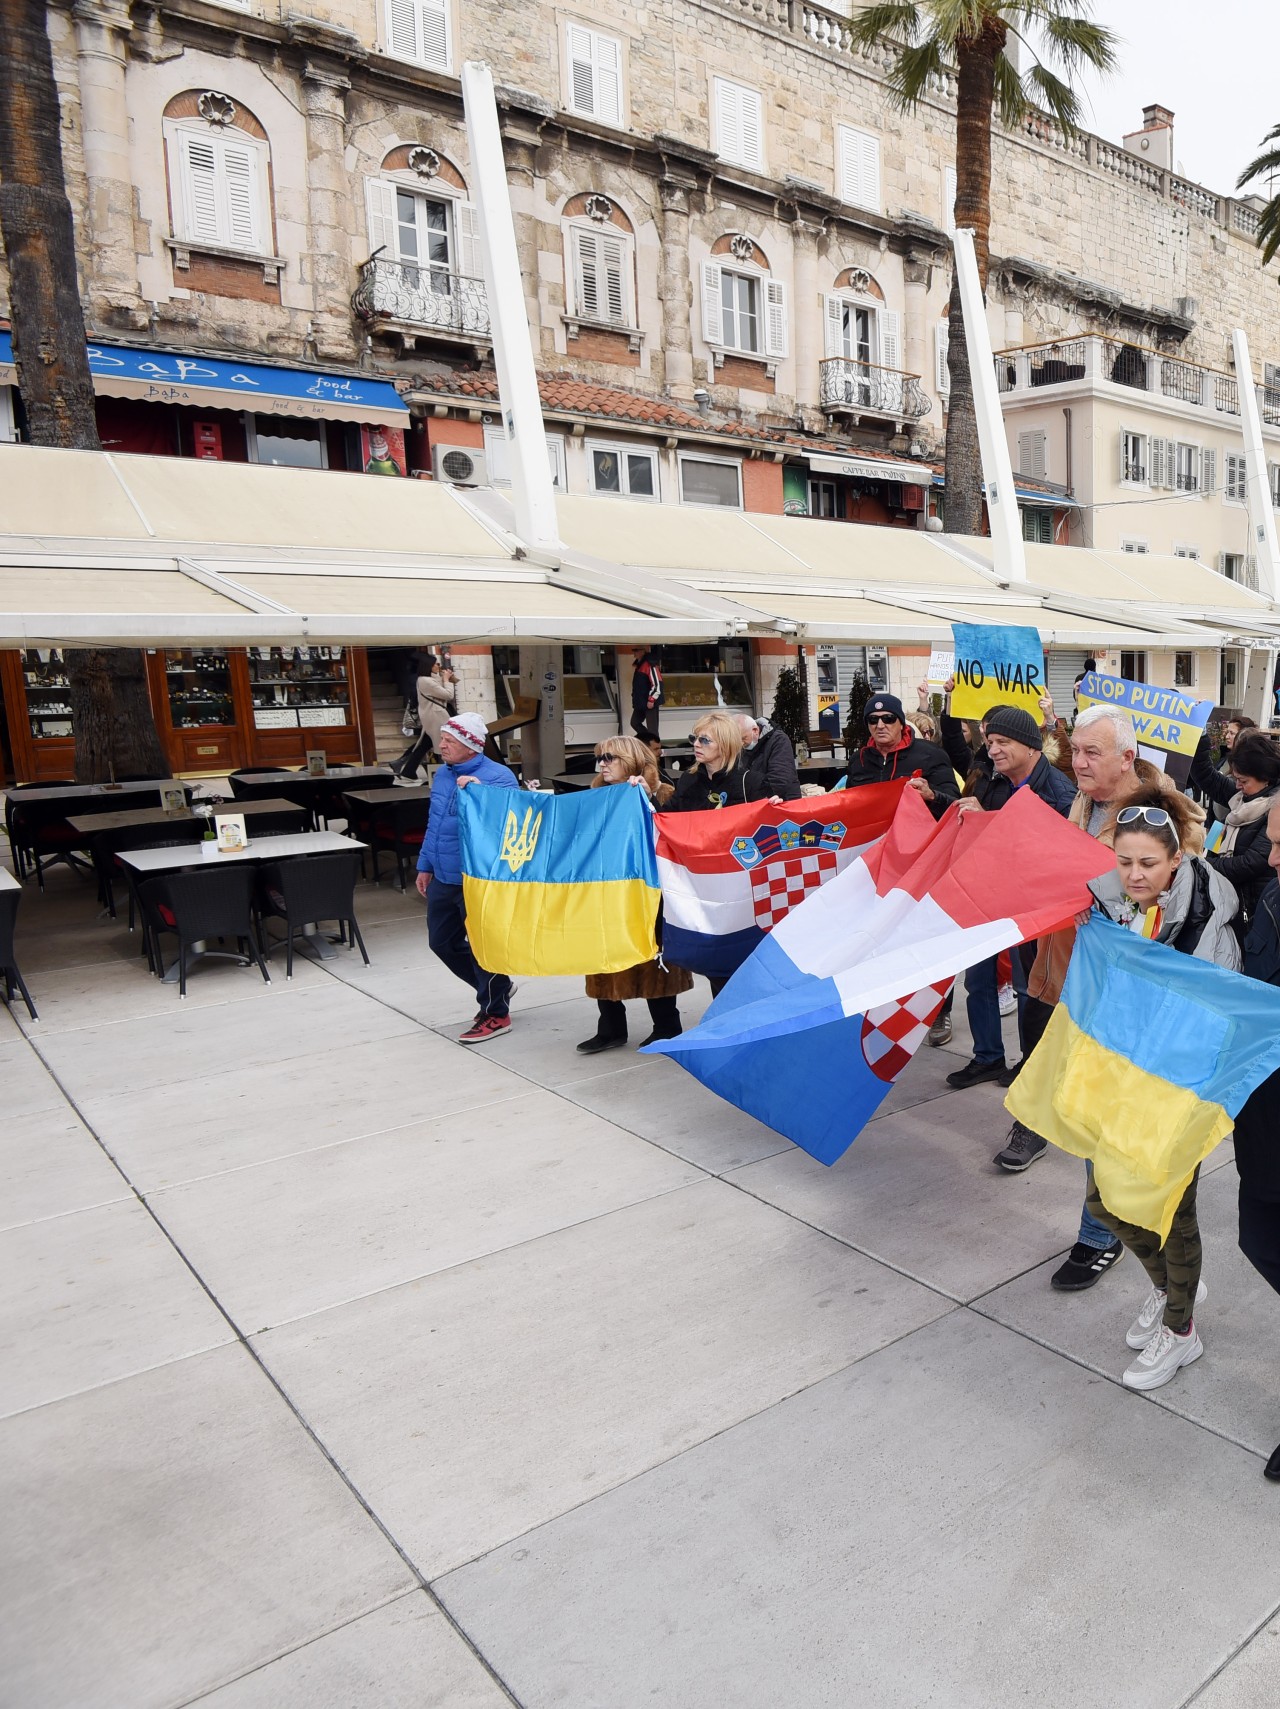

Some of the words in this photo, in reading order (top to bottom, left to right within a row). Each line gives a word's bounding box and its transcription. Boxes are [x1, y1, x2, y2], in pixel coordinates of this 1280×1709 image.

[315, 377, 352, 391] food
[144, 386, 189, 400] BaBa
[333, 391, 364, 401] bar
[270, 400, 289, 411] food
[312, 404, 326, 413] bar
[881, 470, 906, 481] TWINS
[957, 658, 984, 689] NO
[993, 662, 1042, 696] WAR
[1087, 674, 1125, 700] STOP
[1131, 687, 1194, 718] PUTIN
[1131, 714, 1181, 745] WAR
